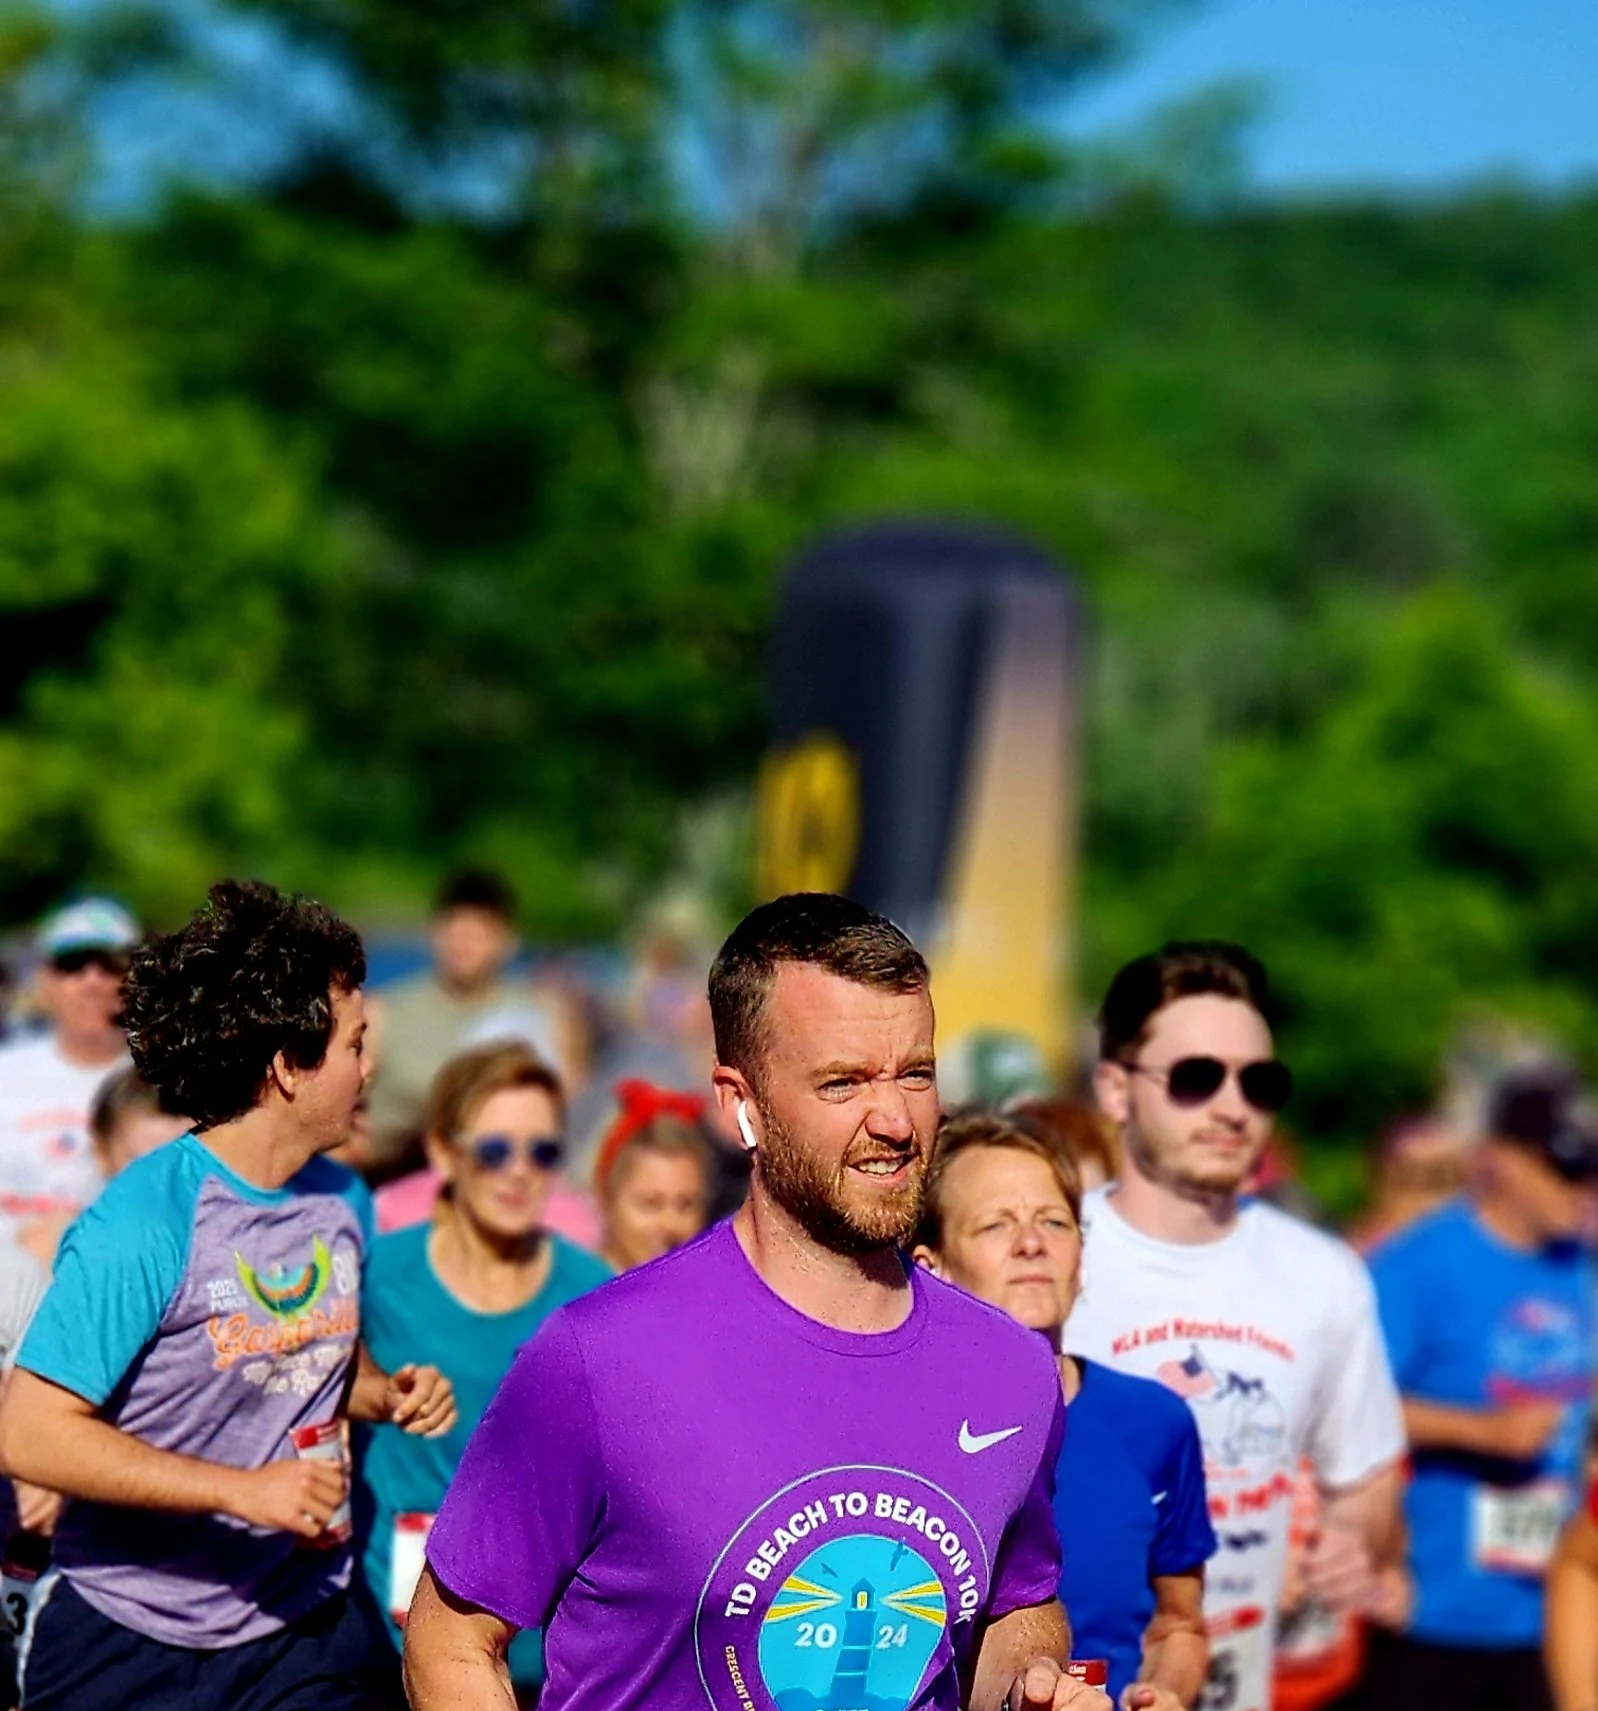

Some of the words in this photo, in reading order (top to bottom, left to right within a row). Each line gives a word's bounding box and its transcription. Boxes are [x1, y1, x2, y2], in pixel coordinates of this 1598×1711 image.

[725, 1582, 757, 1618] TD
[745, 1500, 828, 1581] BEACH
[829, 1492, 868, 1518] TO
[874, 1493, 972, 1577] BEACON
[794, 1623, 837, 1649] 20
[876, 1624, 908, 1650] 24
[725, 1645, 749, 1700] CRESCENT
